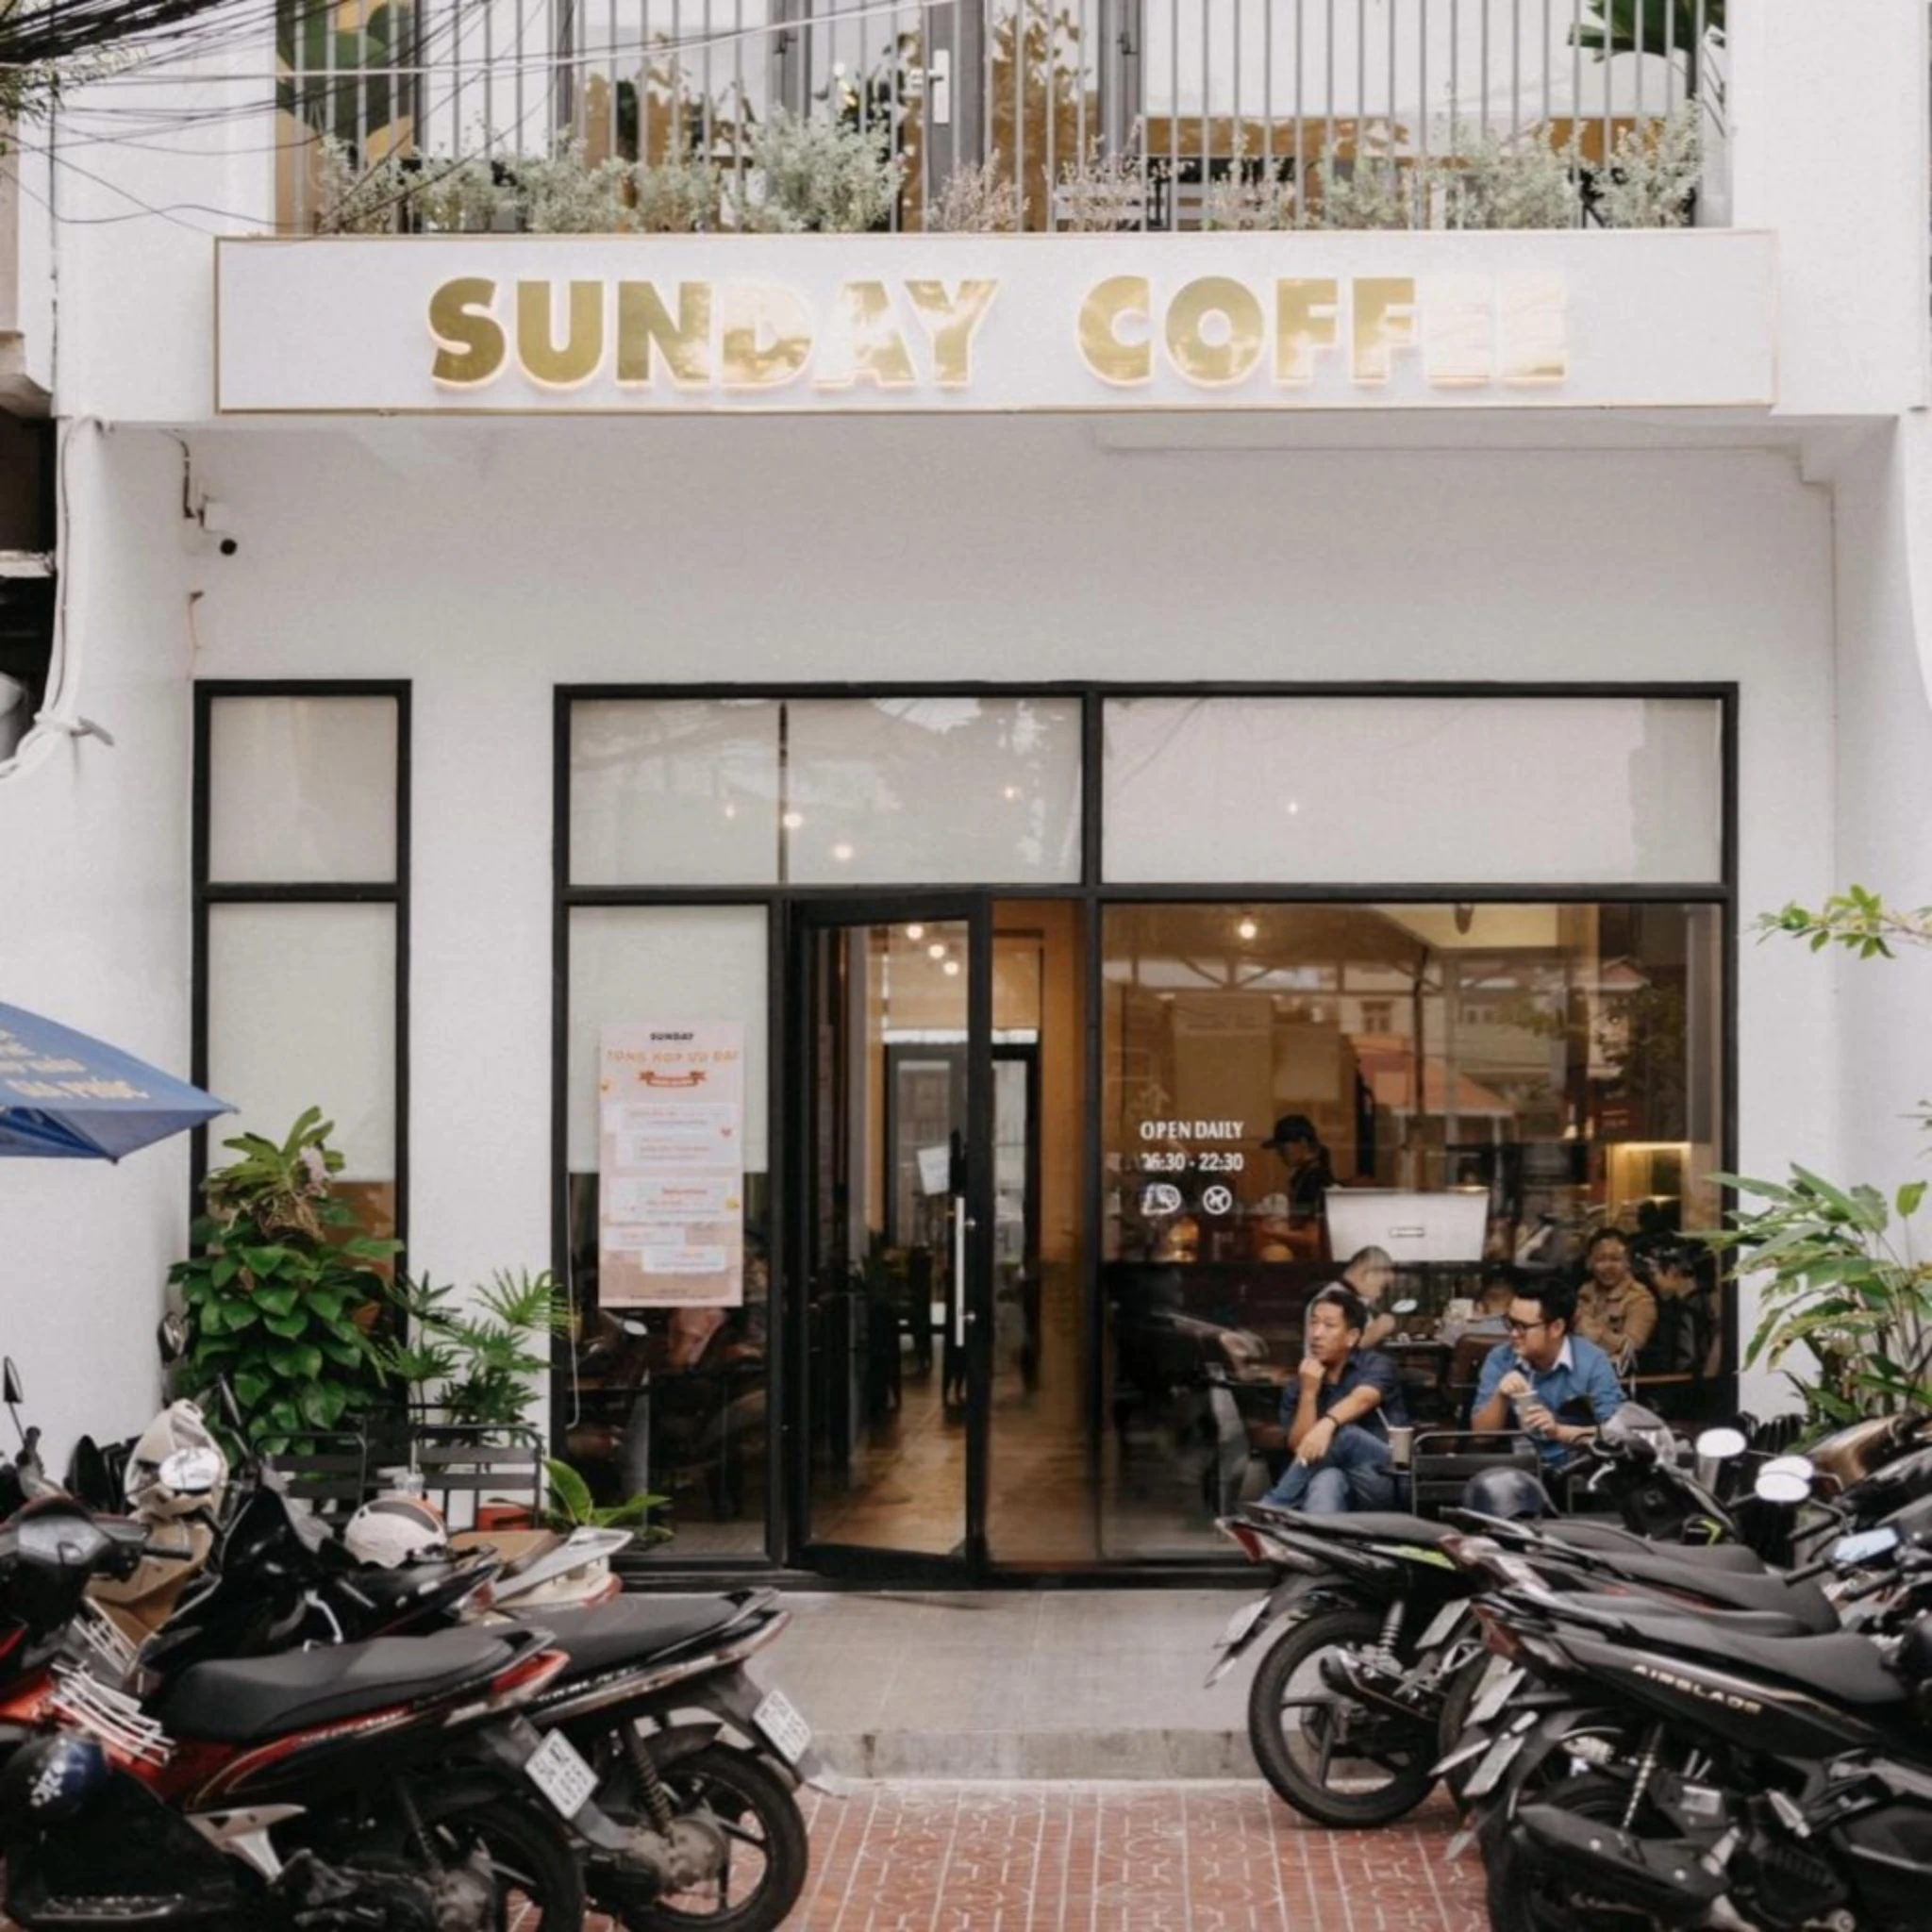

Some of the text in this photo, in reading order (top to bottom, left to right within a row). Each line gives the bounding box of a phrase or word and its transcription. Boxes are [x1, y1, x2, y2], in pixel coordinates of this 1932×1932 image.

[427, 275, 1567, 389] SUNDAY COFFEE
[1140, 1121, 1243, 1140] OPEN DAILY
[1198, 1152, 1244, 1172] 22:30
